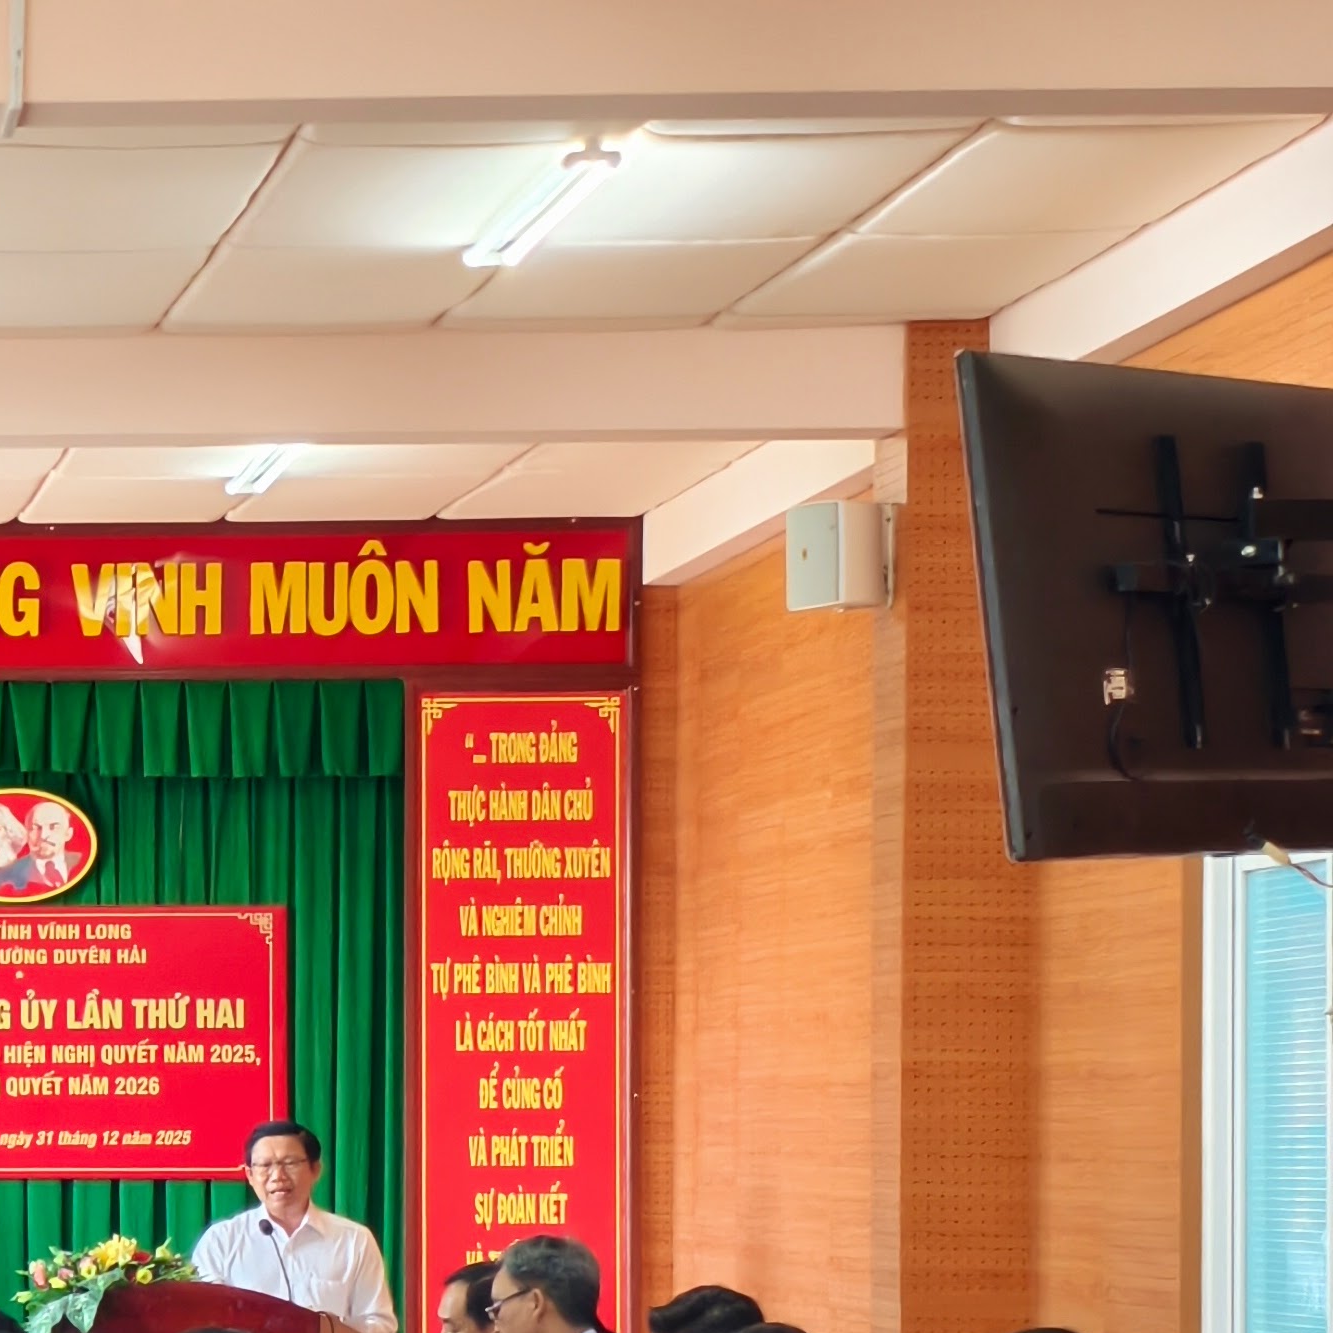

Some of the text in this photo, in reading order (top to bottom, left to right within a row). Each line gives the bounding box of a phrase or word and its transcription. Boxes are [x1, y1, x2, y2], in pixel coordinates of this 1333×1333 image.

[72, 563, 222, 637] VINH
[250, 541, 439, 637] MUÔN
[468, 544, 621, 633] NĂM
[489, 731, 537, 764] TRONG
[538, 719, 578, 764] ĐẢNG
[447, 777, 594, 827] THỰC HÀNH DÂN CHỦ
[431, 838, 611, 886] RỘNG RÃI, THƯỜNG XUYÊN
[37, 921, 81, 940] VĨNH
[85, 923, 132, 940] LONG
[459, 897, 479, 937] VÀ
[481, 896, 537, 937] NGHIÊM
[53, 945, 111, 965] DUYÊN
[116, 944, 147, 964] HẢI
[430, 953, 612, 1001] TỰ PHÊ BÌNH VÀ PHÊ BÌNH
[20, 988, 58, 1030] ỦY
[66, 988, 123, 1030] LẦN
[131, 992, 191, 1030] THỨ
[195, 998, 245, 1029] HAI
[455, 1007, 588, 1053] LÀ CÁCH TỐT NHẤT
[3, 1040, 46, 1068] HIỆN
[51, 1044, 96, 1068] NGHỊ
[100, 1038, 159, 1066] QUYẾT
[163, 1041, 205, 1064] NĂM
[210, 1044, 261, 1066] 2025,
[5, 1070, 64, 1098] QUYẾT
[68, 1073, 109, 1096] NĂM
[114, 1076, 160, 1096] 2026
[478, 1061, 565, 1110] ĐỂ CỦNG CỐ
[35, 1130, 54, 1146] 31
[57, 1130, 98, 1149] tháng
[102, 1130, 120, 1146] 12
[121, 1130, 153, 1145] năm
[155, 1129, 192, 1146] 2025
[468, 1118, 575, 1167] VÀ PHÁT TRIỂN
[474, 1180, 569, 1232] SỰ ĐOÀN KẾT
